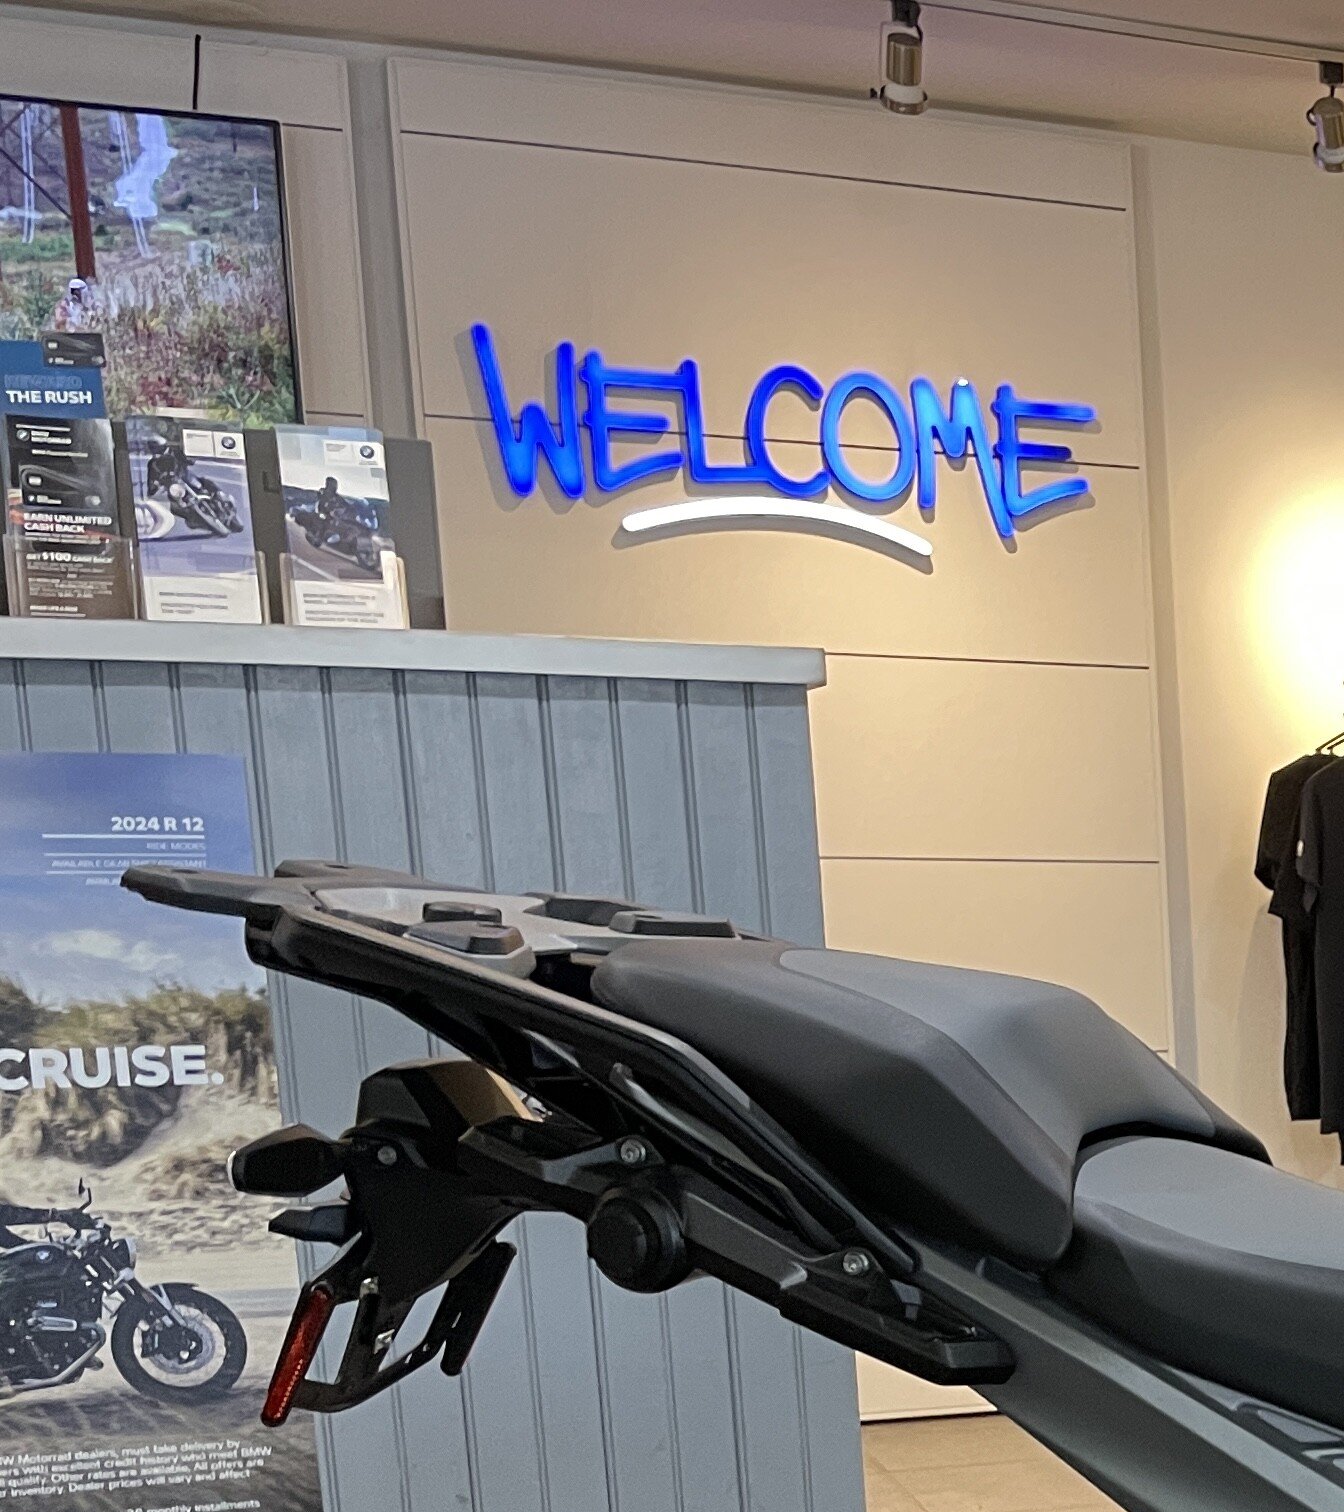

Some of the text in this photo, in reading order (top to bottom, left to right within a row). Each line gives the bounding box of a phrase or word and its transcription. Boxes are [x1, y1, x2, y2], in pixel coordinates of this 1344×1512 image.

[5, 390, 92, 404] THE RUSH
[471, 322, 1096, 537] WELCOME
[53, 514, 112, 525] UNLIMITED
[55, 524, 85, 533] BACK
[42, 551, 72, 562] $100
[111, 816, 205, 832] 2024 R 12
[0, 1044, 224, 1091] CRUISE.
[226, 1439, 240, 1449] by
[241, 1446, 272, 1457] BMW
[193, 1461, 208, 1471] All
[246, 1458, 264, 1467] are
[68, 1481, 105, 1493] Dealer
